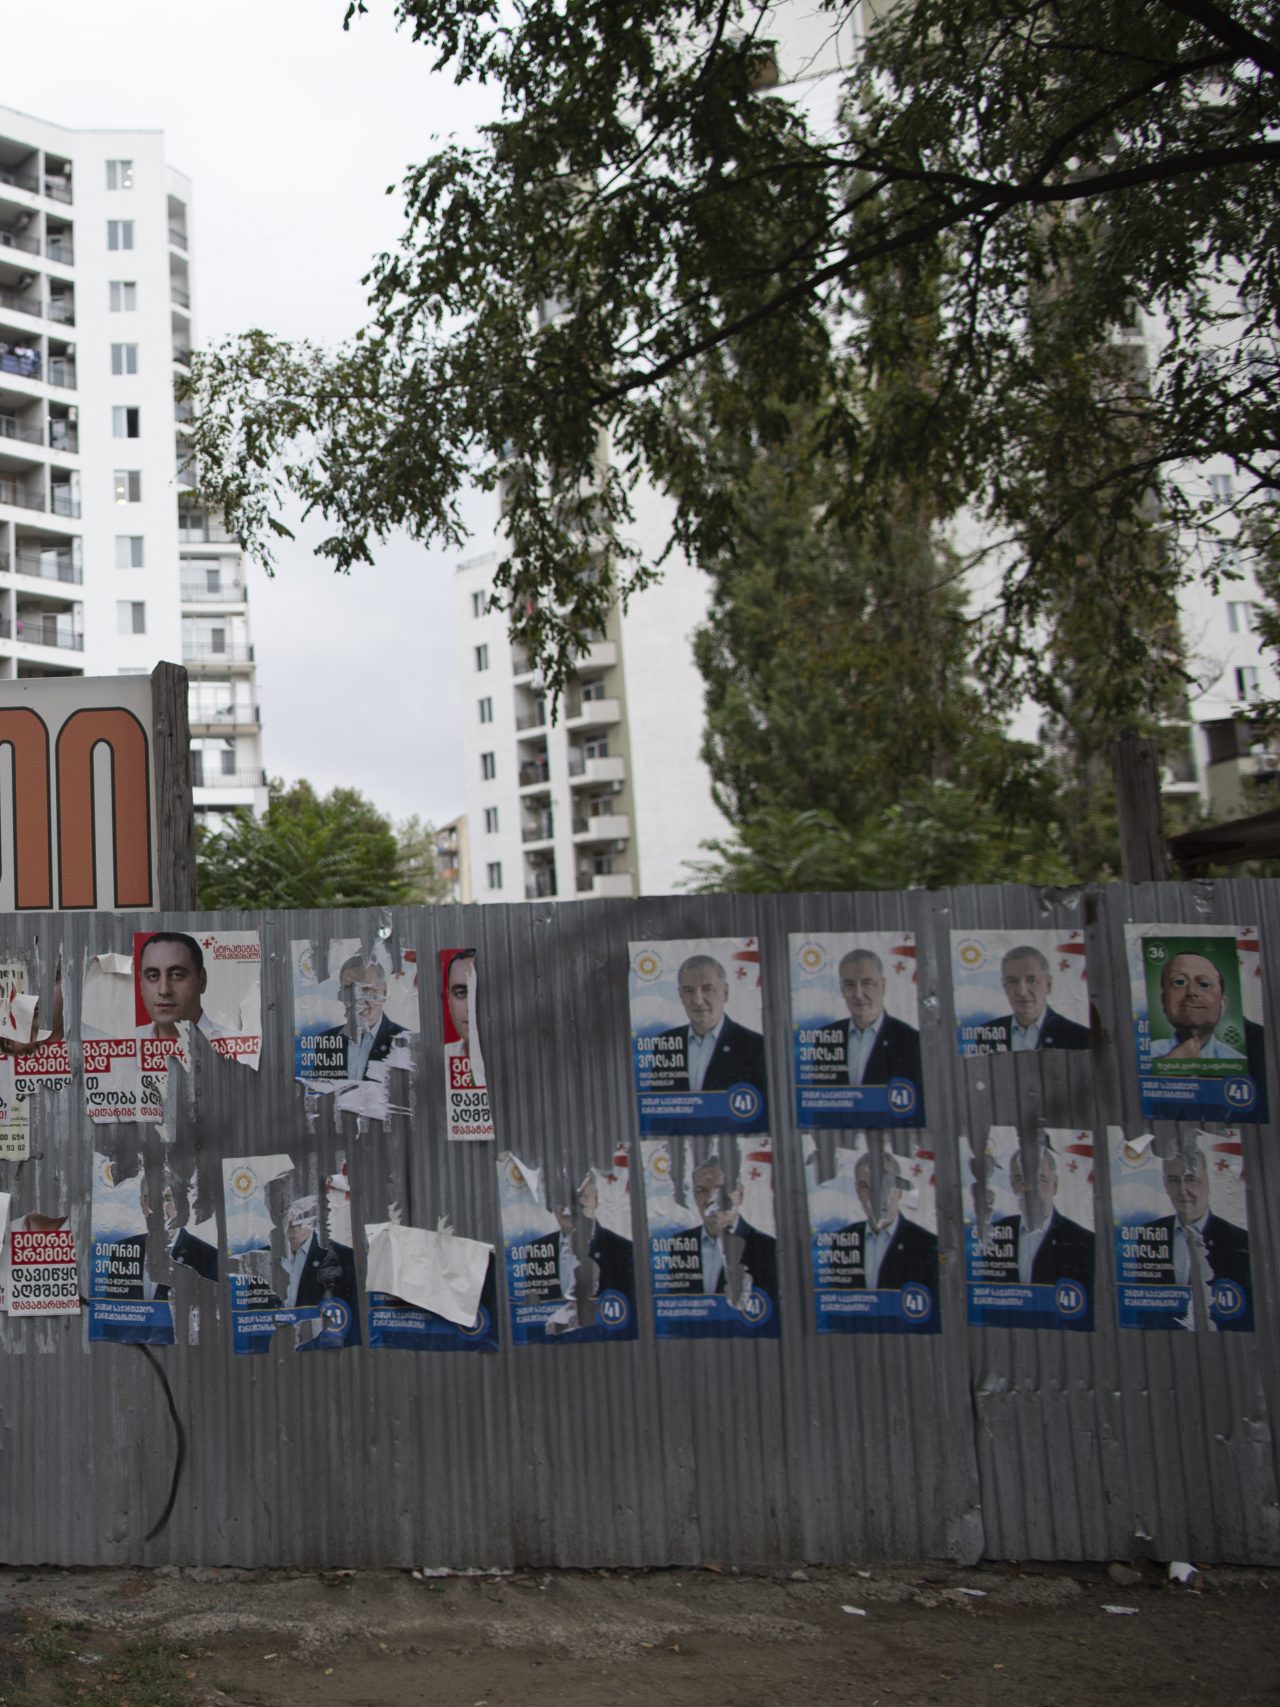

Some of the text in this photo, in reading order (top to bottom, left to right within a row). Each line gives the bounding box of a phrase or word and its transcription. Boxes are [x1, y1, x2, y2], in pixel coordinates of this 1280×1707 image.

[1149, 947, 1164, 959] 36
[83, 1041, 135, 1056] ვაშაძე
[300, 1035, 344, 1050] გიორგი
[637, 1036, 683, 1051] გიორგი
[17, 1057, 107, 1073] პრემიეად
[300, 1052, 344, 1067] ვოლსკი
[638, 1053, 684, 1068] ვოლსკი
[891, 1090, 909, 1106] 41
[1229, 1084, 1249, 1100] 41
[735, 1096, 752, 1111] 41
[95, 1242, 141, 1258] გიორგი
[511, 1243, 555, 1259] გიორგი
[95, 1260, 140, 1276] ვოლსკი
[513, 1261, 556, 1277] ვოლსკი
[906, 1296, 924, 1312] 41
[1059, 1291, 1077, 1306] 41
[1218, 1291, 1235, 1307] 41
[604, 1301, 620, 1317] 41
